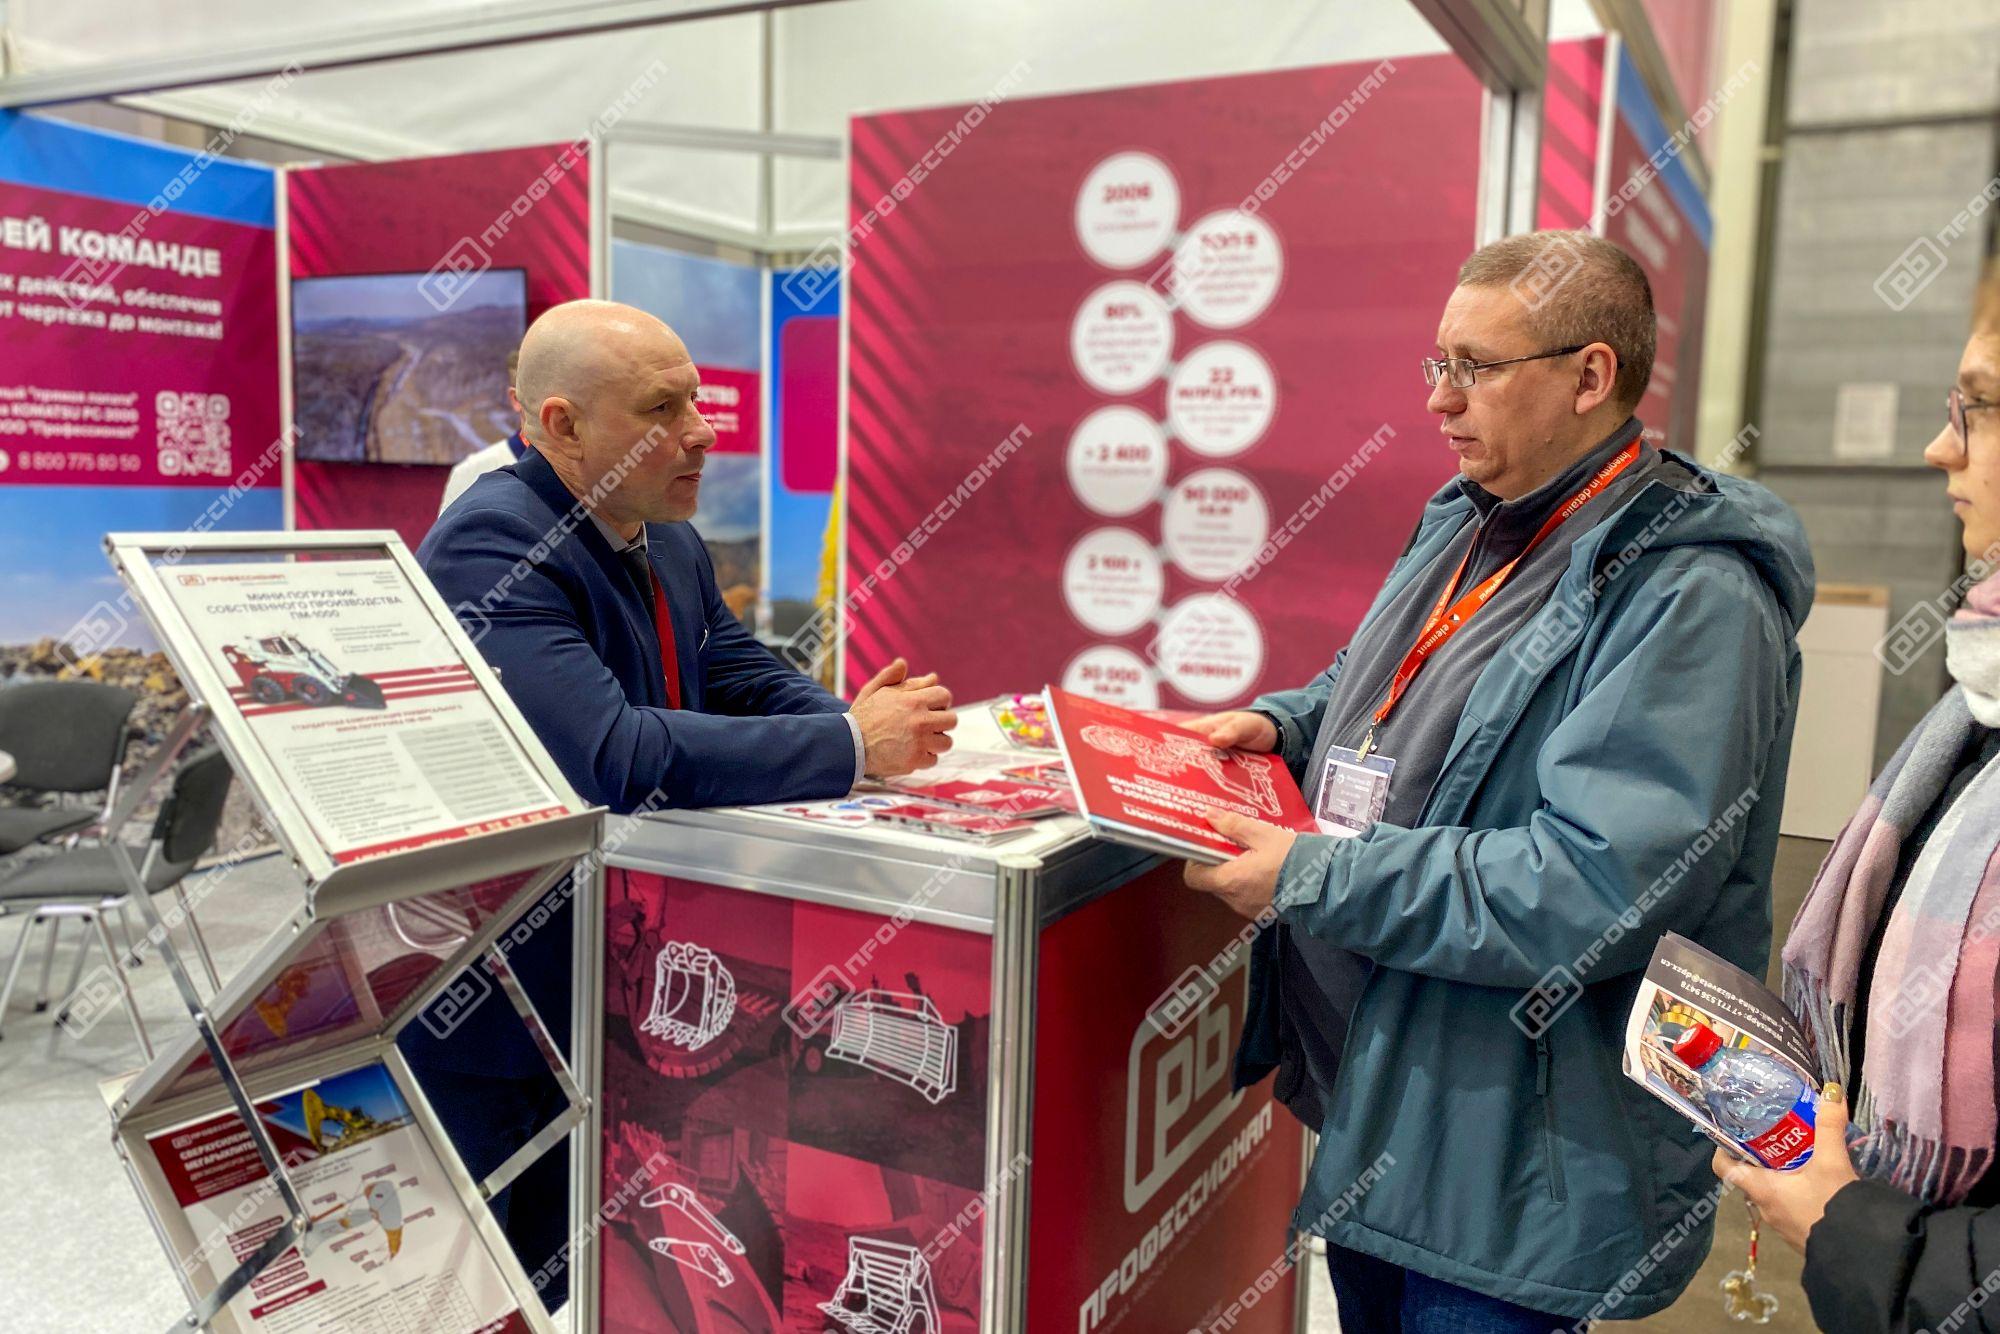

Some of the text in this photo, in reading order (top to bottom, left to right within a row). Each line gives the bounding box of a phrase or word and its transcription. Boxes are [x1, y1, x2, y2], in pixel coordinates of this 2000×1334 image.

[0, 216, 222, 278] ЕЙ КОМАНДЕ
[17, 276, 121, 306] действий,
[122, 288, 222, 316] обеспечив
[17, 303, 106, 328] чертежа
[108, 313, 136, 332] до
[138, 316, 223, 340] монтажа!
[18, 451, 31, 470] 8
[32, 451, 66, 470] 800
[1562, 450, 1632, 518] Integrity in details
[206, 596, 404, 615] СОБСТВЕННОГО ПРОИЗВОДСТВА
[1417, 623, 1449, 655] element
[1107, 775, 1208, 812] БОРУДОВАНИЯ
[1123, 806, 1237, 845] ФЕССИОНАЛ
[184, 1142, 257, 1172] МЕГАРЫХЛИТЕ
[1760, 1126, 1809, 1160] MEVER
[1079, 1100, 1272, 1334] ПРОФЕССИОНАЛ
